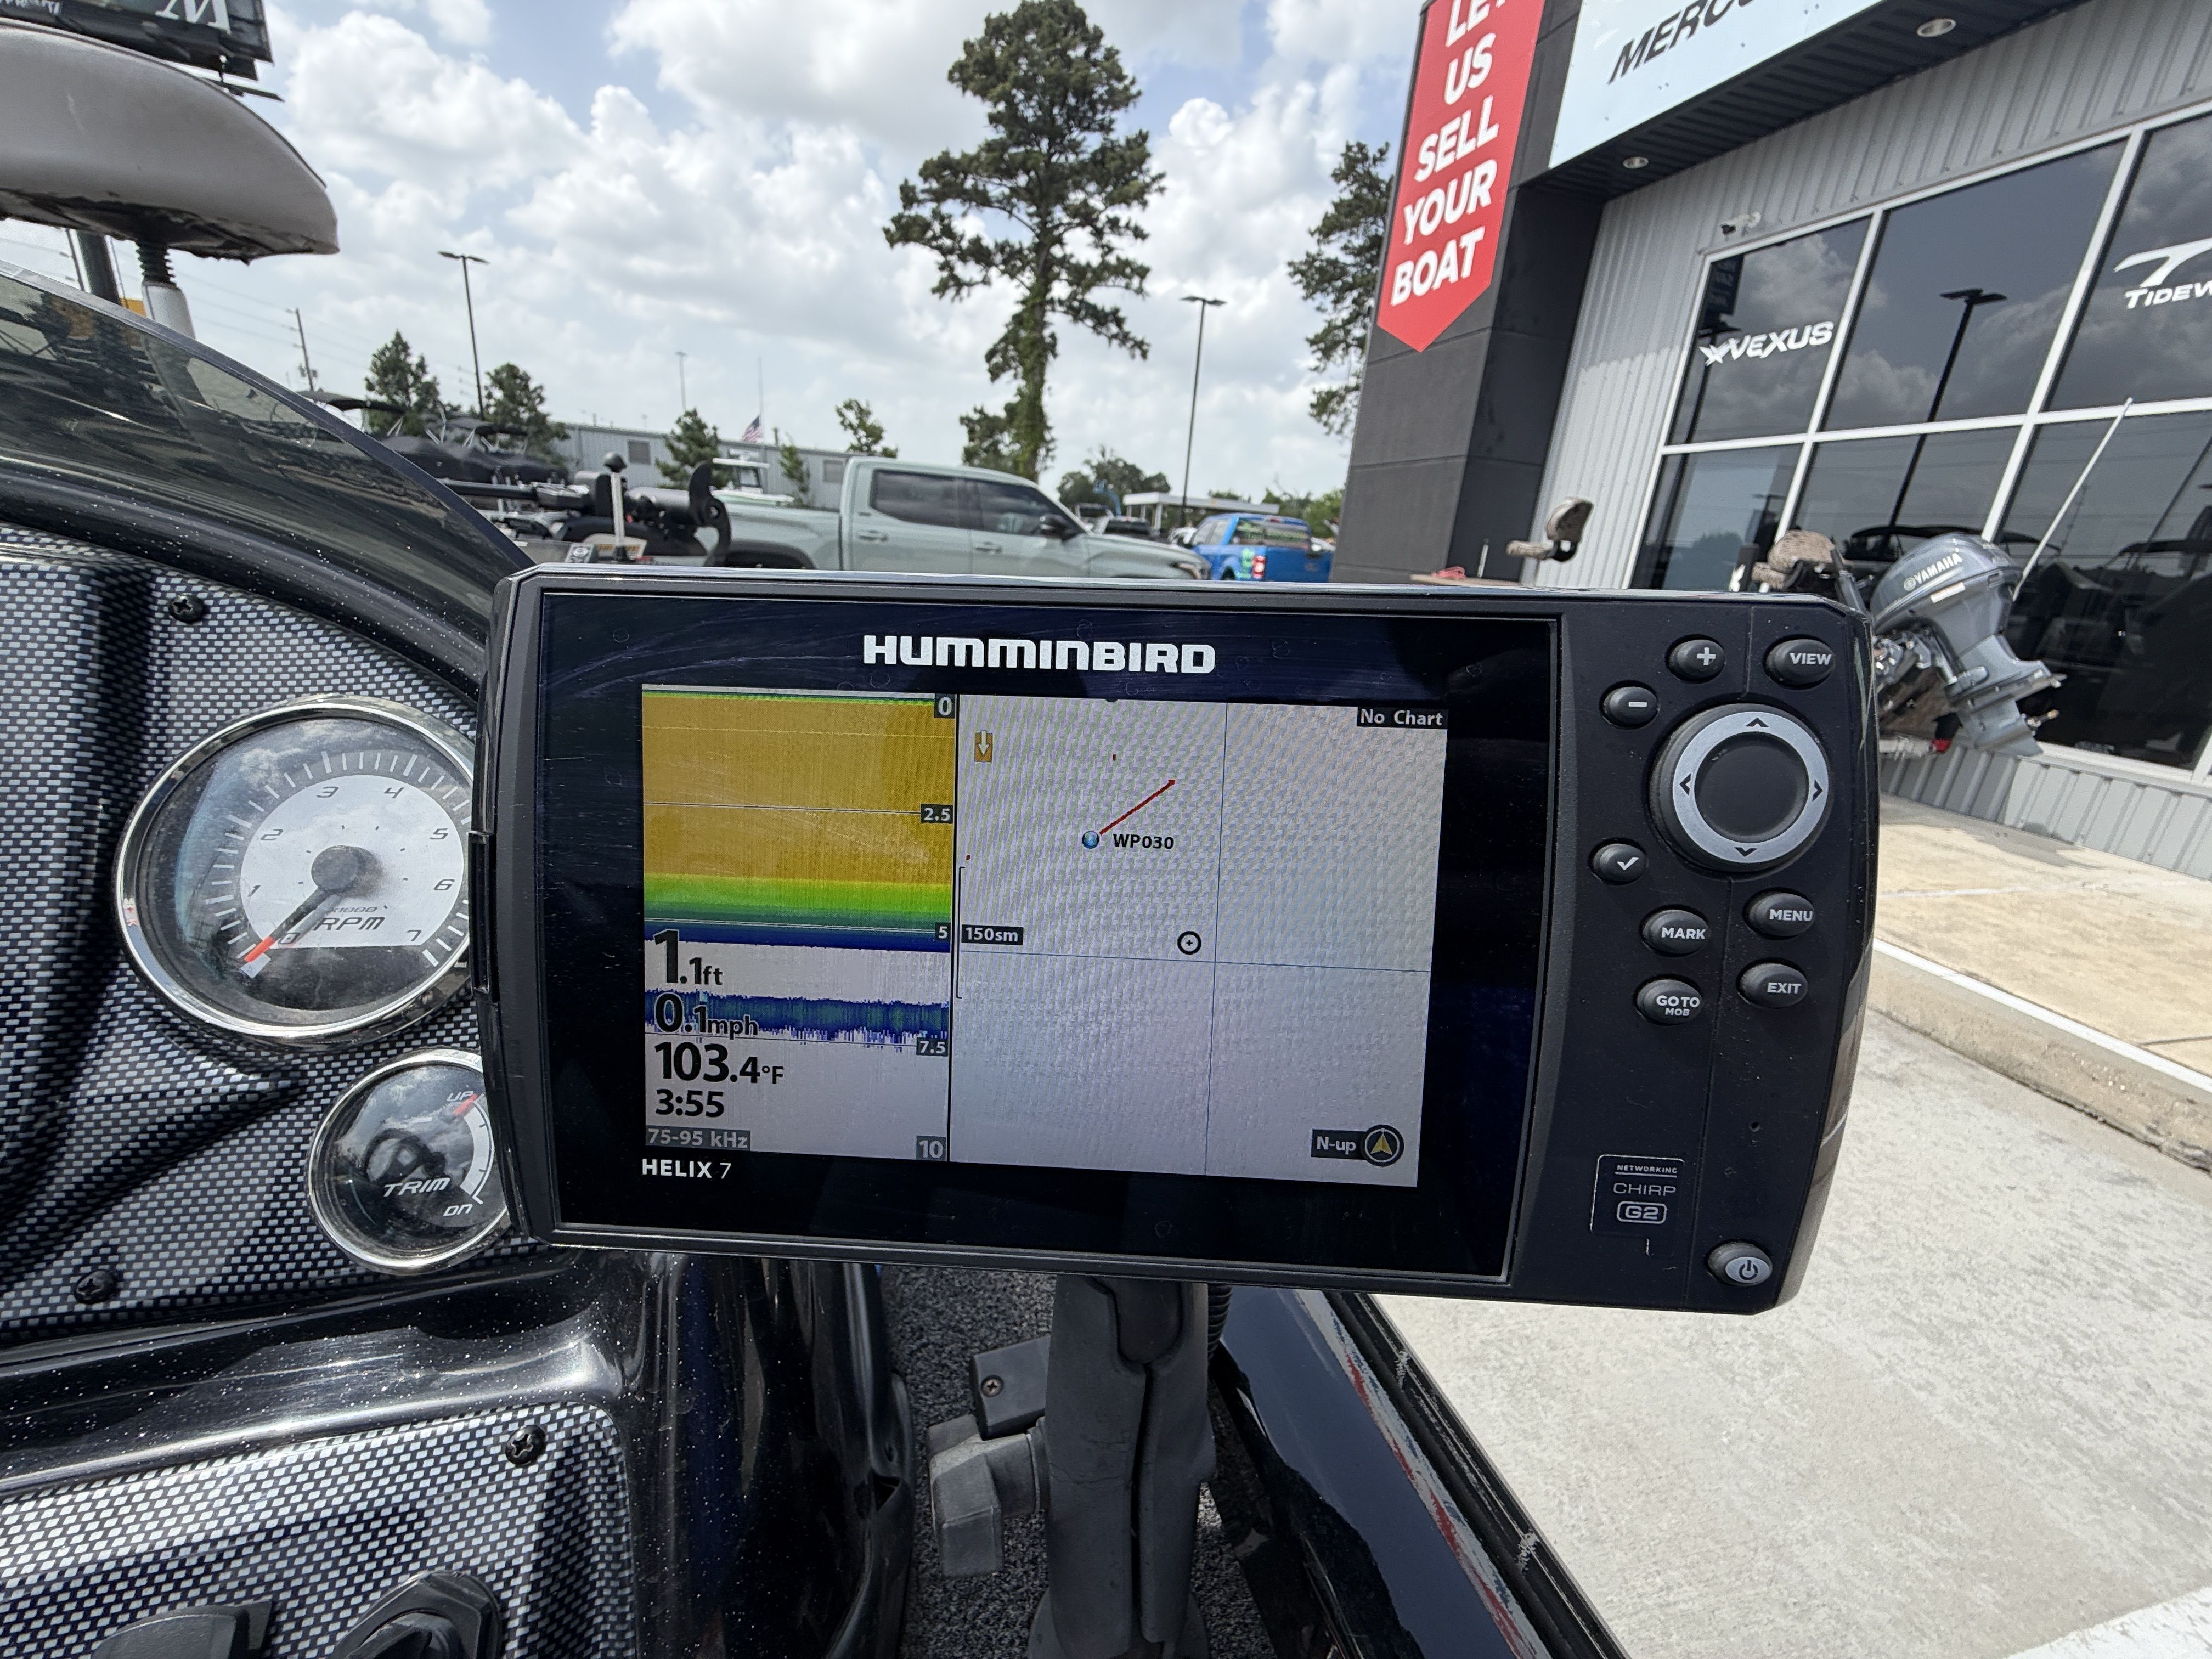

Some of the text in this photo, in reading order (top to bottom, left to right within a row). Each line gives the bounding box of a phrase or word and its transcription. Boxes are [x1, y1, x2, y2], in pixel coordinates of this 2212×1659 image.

[1445, 0, 1505, 47] LE
[1444, 32, 1497, 105] US
[1414, 95, 1499, 182] SELL
[1403, 159, 1497, 245] YOUR
[1390, 225, 1486, 307] BOAT
[1728, 321, 1835, 361] VEXUS
[1914, 553, 1962, 584] YAMAHA
[864, 635, 1216, 674] HUMMINBIRD
[1790, 653, 1832, 665] VIEW
[938, 697, 952, 716] 0
[1361, 709, 1443, 726] No Chart
[317, 786, 339, 798] 3
[384, 787, 404, 799] 4
[924, 808, 951, 821] 2.5
[261, 829, 284, 841] 2
[430, 828, 449, 840] 5
[1113, 833, 1174, 849] WP030
[247, 885, 261, 898] 1
[433, 879, 455, 891] 6
[1769, 909, 1813, 922] MENU
[312, 917, 386, 931] RPM
[406, 929, 422, 941] 7
[938, 926, 948, 939] 5
[966, 927, 1018, 942] 150sm
[1661, 927, 1707, 940] MARK
[1767, 983, 1802, 994] EXIT
[1665, 1008, 1690, 1017] MOB
[919, 1041, 946, 1054] 7.5
[447, 1091, 474, 1102] UP
[656, 1088, 724, 1118] 3:55
[648, 1128, 748, 1148] 75-95 kHz
[919, 1140, 944, 1159] 10
[1317, 1136, 1357, 1155] N-up
[642, 1158, 732, 1179] HELIX 7
[1617, 1164, 1677, 1173] NETWORKING
[383, 1177, 450, 1197] TRIM
[1613, 1183, 1676, 1196] CHIRP
[1625, 1205, 1659, 1220] G2
